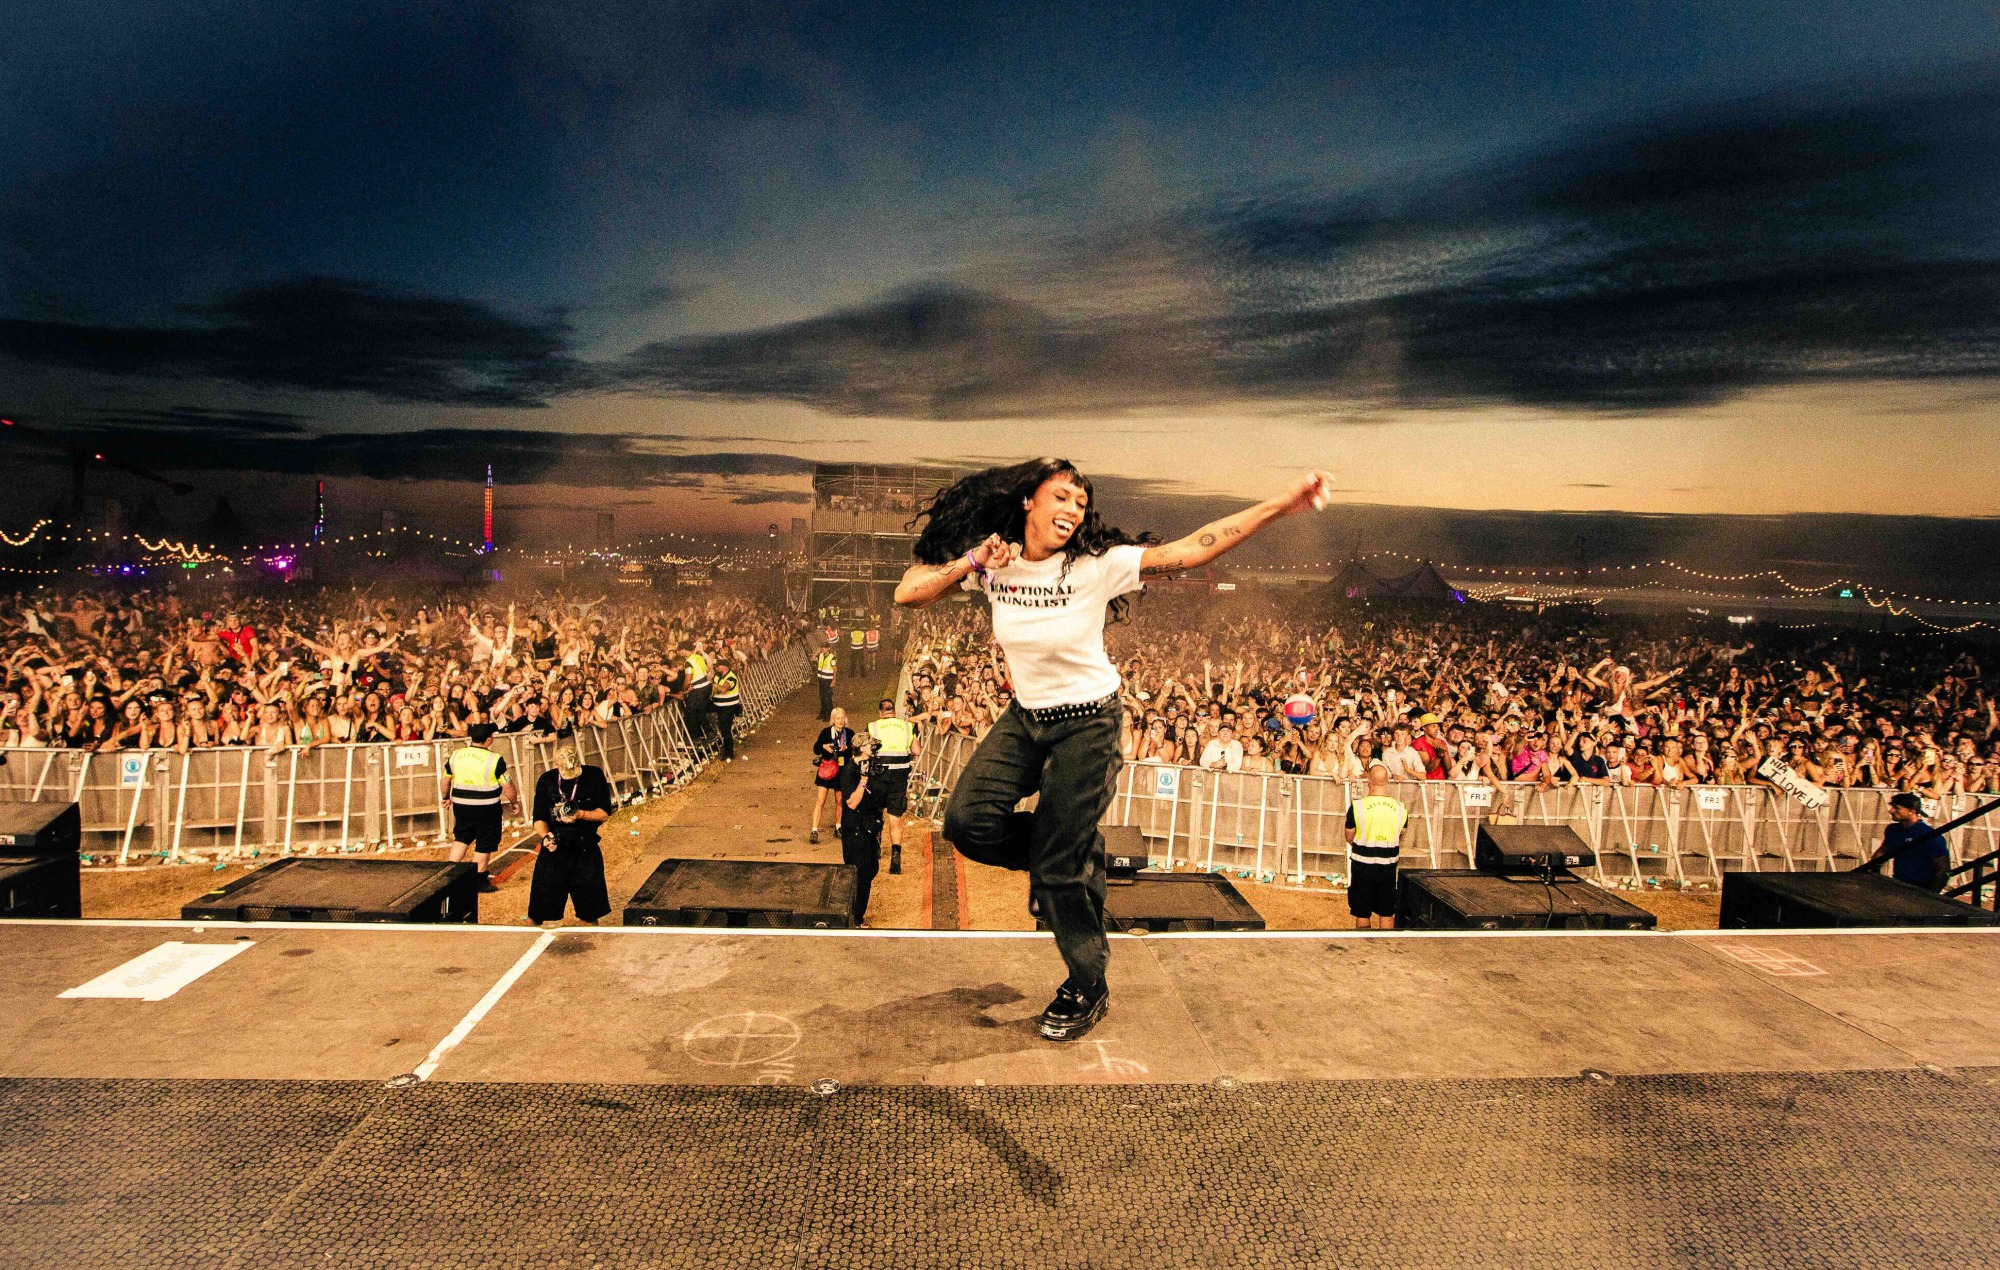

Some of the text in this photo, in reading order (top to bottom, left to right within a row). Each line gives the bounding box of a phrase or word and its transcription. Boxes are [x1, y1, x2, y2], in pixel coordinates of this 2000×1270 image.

[404, 752, 415, 760] FL
[1770, 759, 1788, 774] NIA
[1771, 768, 1819, 810] I LOVE U
[1482, 793, 1487, 801] 2
[1705, 796, 1715, 804] FR
[1366, 801, 1397, 812] SECURITY
